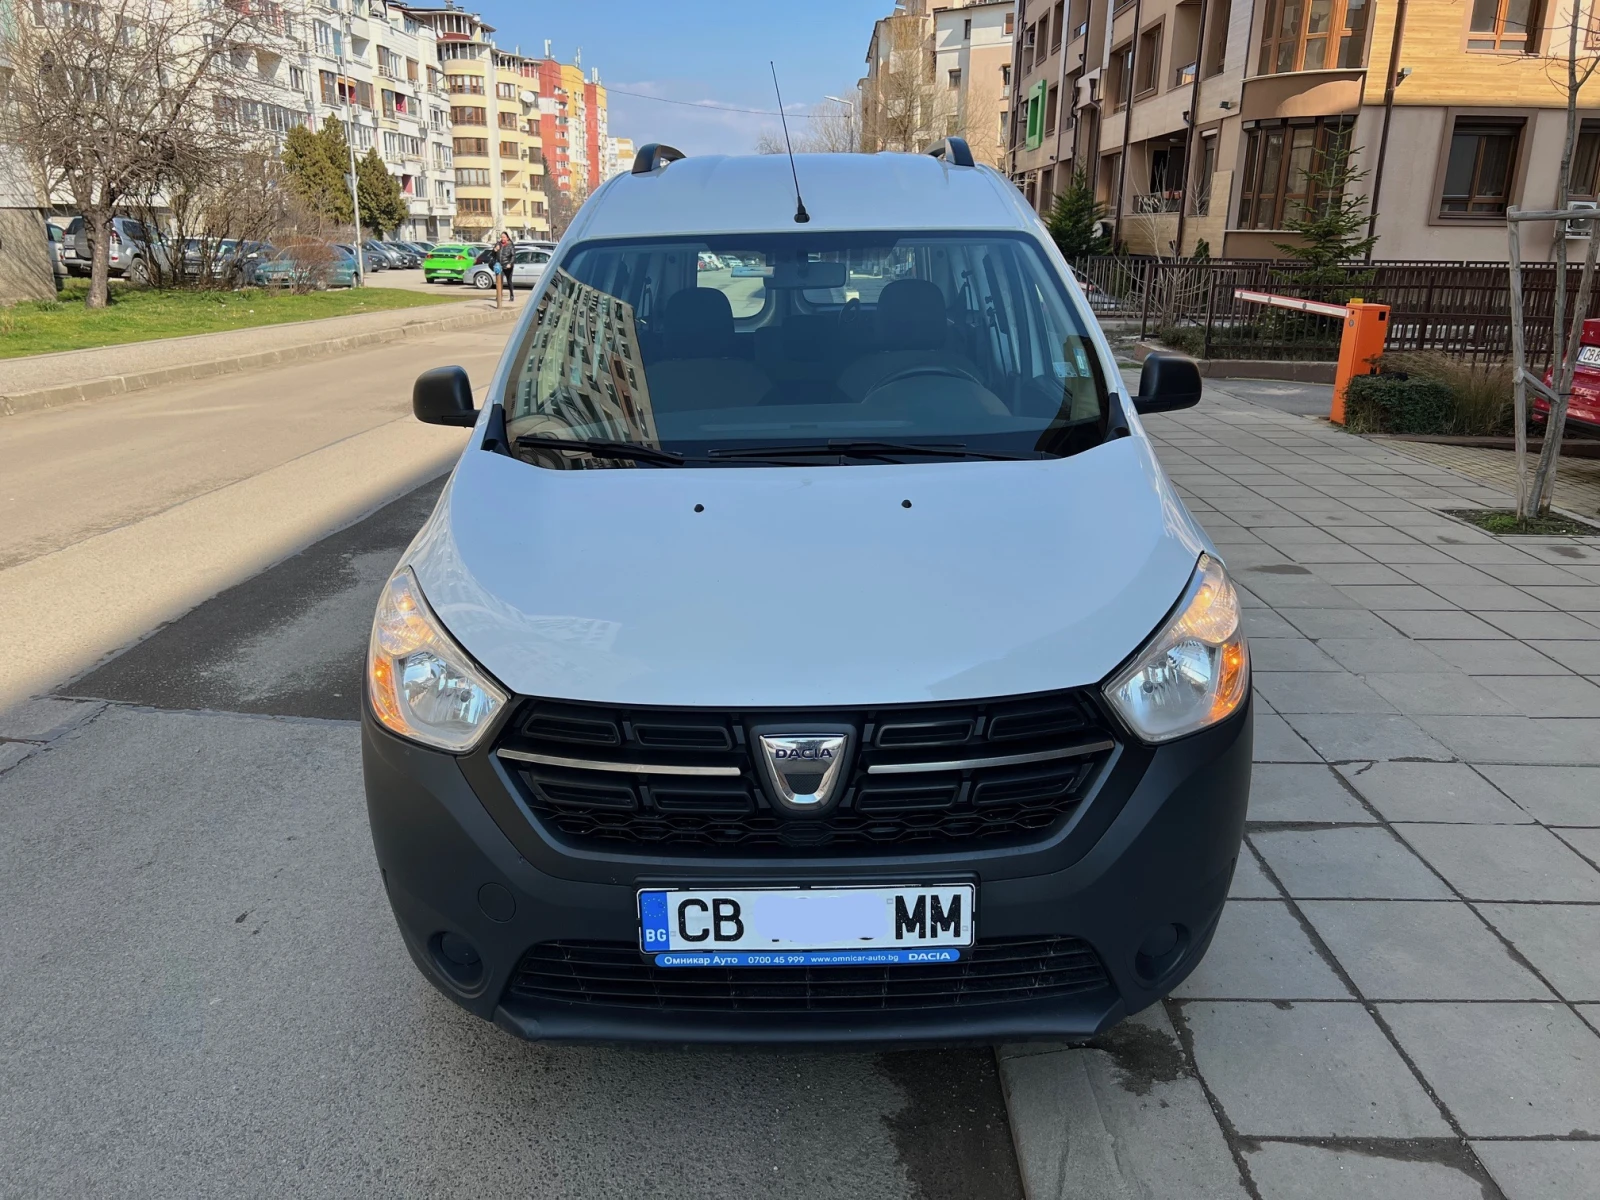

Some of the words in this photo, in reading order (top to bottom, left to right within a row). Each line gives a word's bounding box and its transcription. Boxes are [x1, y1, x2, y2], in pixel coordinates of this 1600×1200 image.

[775, 748, 833, 759] DACIA
[677, 897, 745, 943] CB
[895, 894, 962, 940] MM
[645, 928, 667, 942] BG
[664, 956, 711, 965] Омникар
[713, 955, 738, 965] Ауто
[748, 956, 771, 964] 0700
[773, 955, 785, 963] 45
[787, 955, 805, 963] 999
[810, 953, 899, 963] www.omnicar-auto.bg
[908, 952, 951, 961] DACIA
